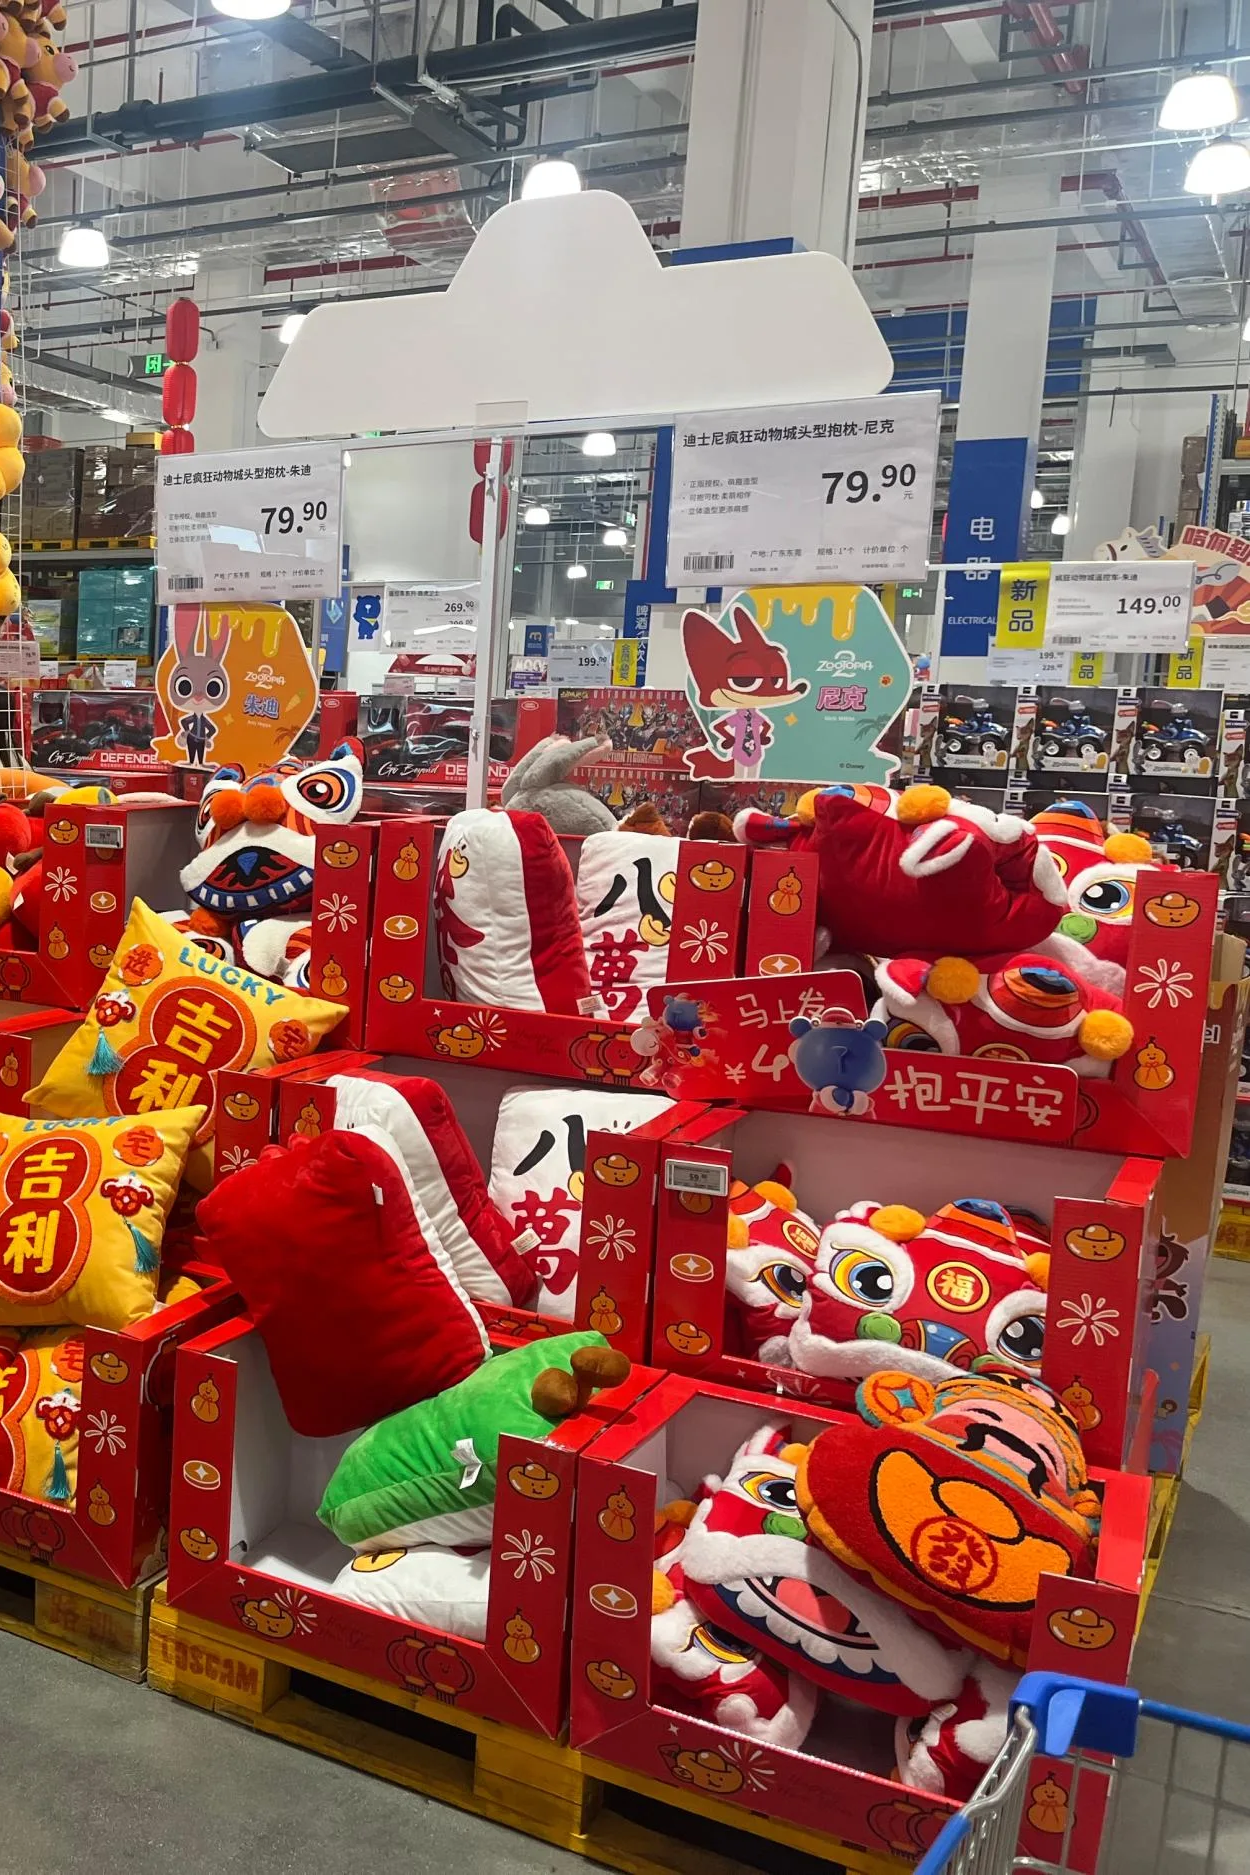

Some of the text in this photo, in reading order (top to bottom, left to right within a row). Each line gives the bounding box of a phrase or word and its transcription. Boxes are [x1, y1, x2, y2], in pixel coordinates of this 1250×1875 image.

[683, 419, 895, 447] 迪士尼疯狂动物城头型抱枕-尼克
[163, 464, 312, 486] 迪士尼疯狂动物城头型抱枕-朱迪
[821, 463, 916, 505] 79.90
[903, 490, 914, 500] 元
[261, 500, 328, 535] 79.90
[964, 517, 995, 581] 电器
[444, 600, 475, 612] 269.00
[1008, 579, 1038, 632] 新品
[1116, 595, 1181, 614] 149.00
[244, 671, 286, 686] ZOOTOPIA
[816, 660, 874, 672] ZOOTOPIA
[244, 693, 280, 719] 朱迪
[816, 685, 868, 711] 尼克
[100, 753, 158, 765] DEFENDE
[178, 946, 286, 1006] LUCKY
[129, 997, 233, 1114] 吉利
[884, 1065, 1064, 1127] 抱平安
[3, 1147, 75, 1275] 吉利
[937, 1268, 977, 1304] 福
[927, 1522, 988, 1591] 發
[160, 1635, 259, 1696] LOSCAM
